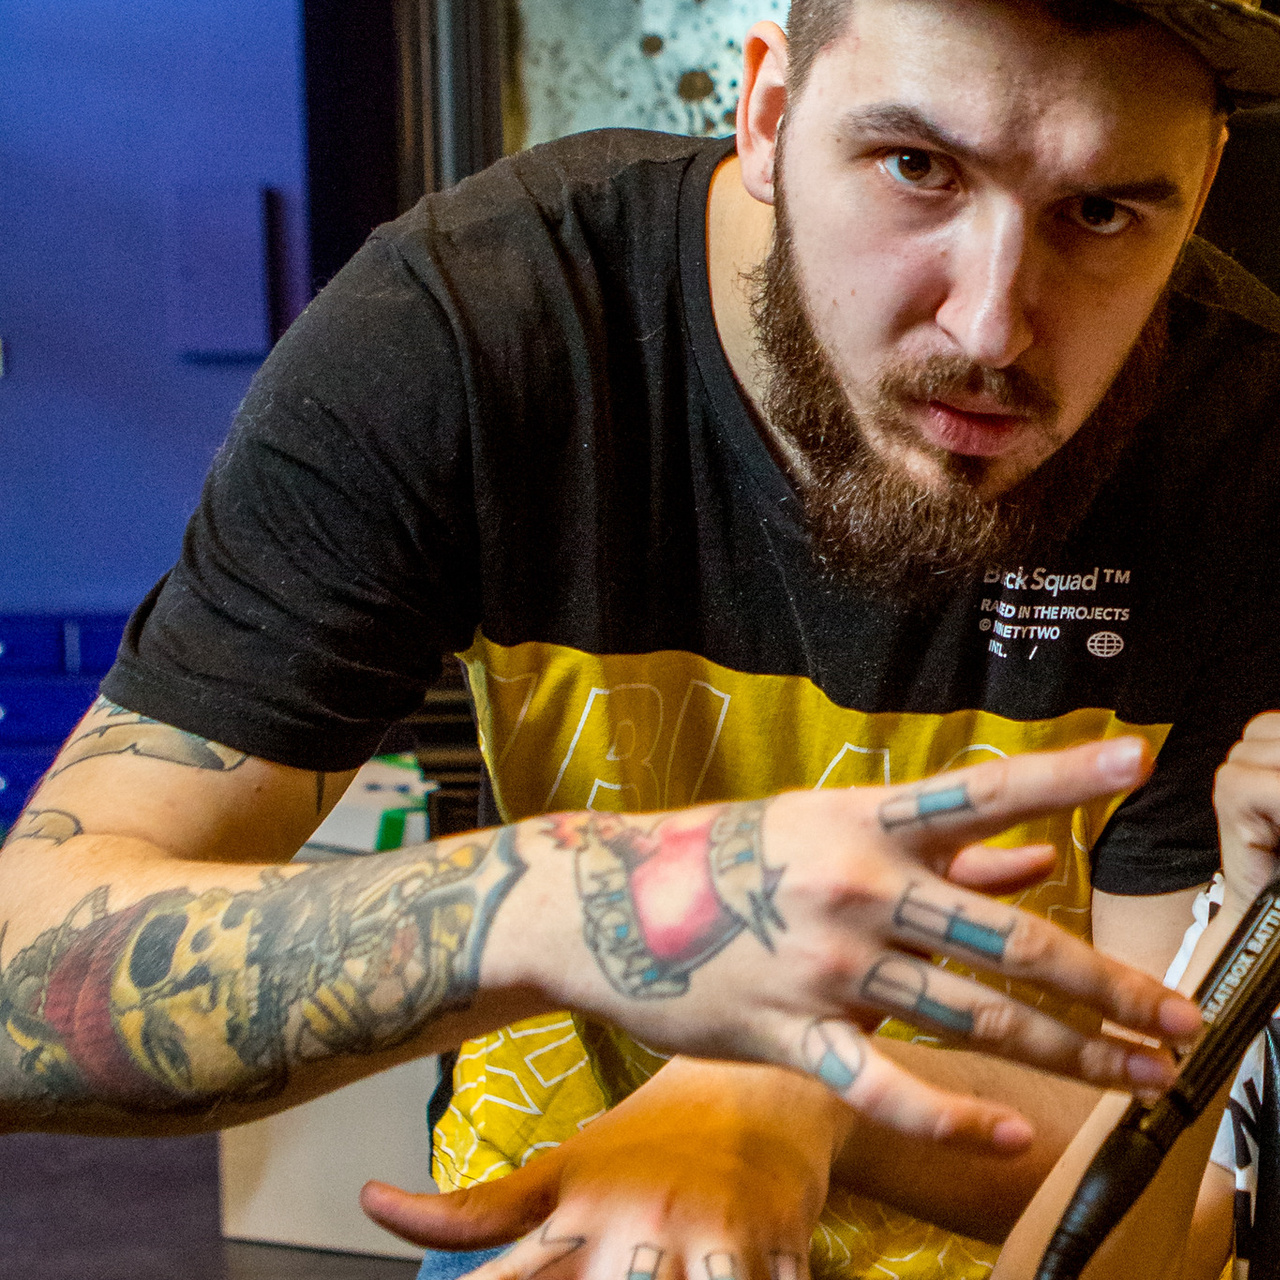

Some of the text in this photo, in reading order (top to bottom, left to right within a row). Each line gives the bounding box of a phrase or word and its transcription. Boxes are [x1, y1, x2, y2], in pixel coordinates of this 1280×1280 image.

[1030, 566, 1099, 597] Squad
[1017, 605, 1031, 619] IN
[1033, 605, 1060, 620] THE
[1060, 606, 1131, 622] PROJECTS
